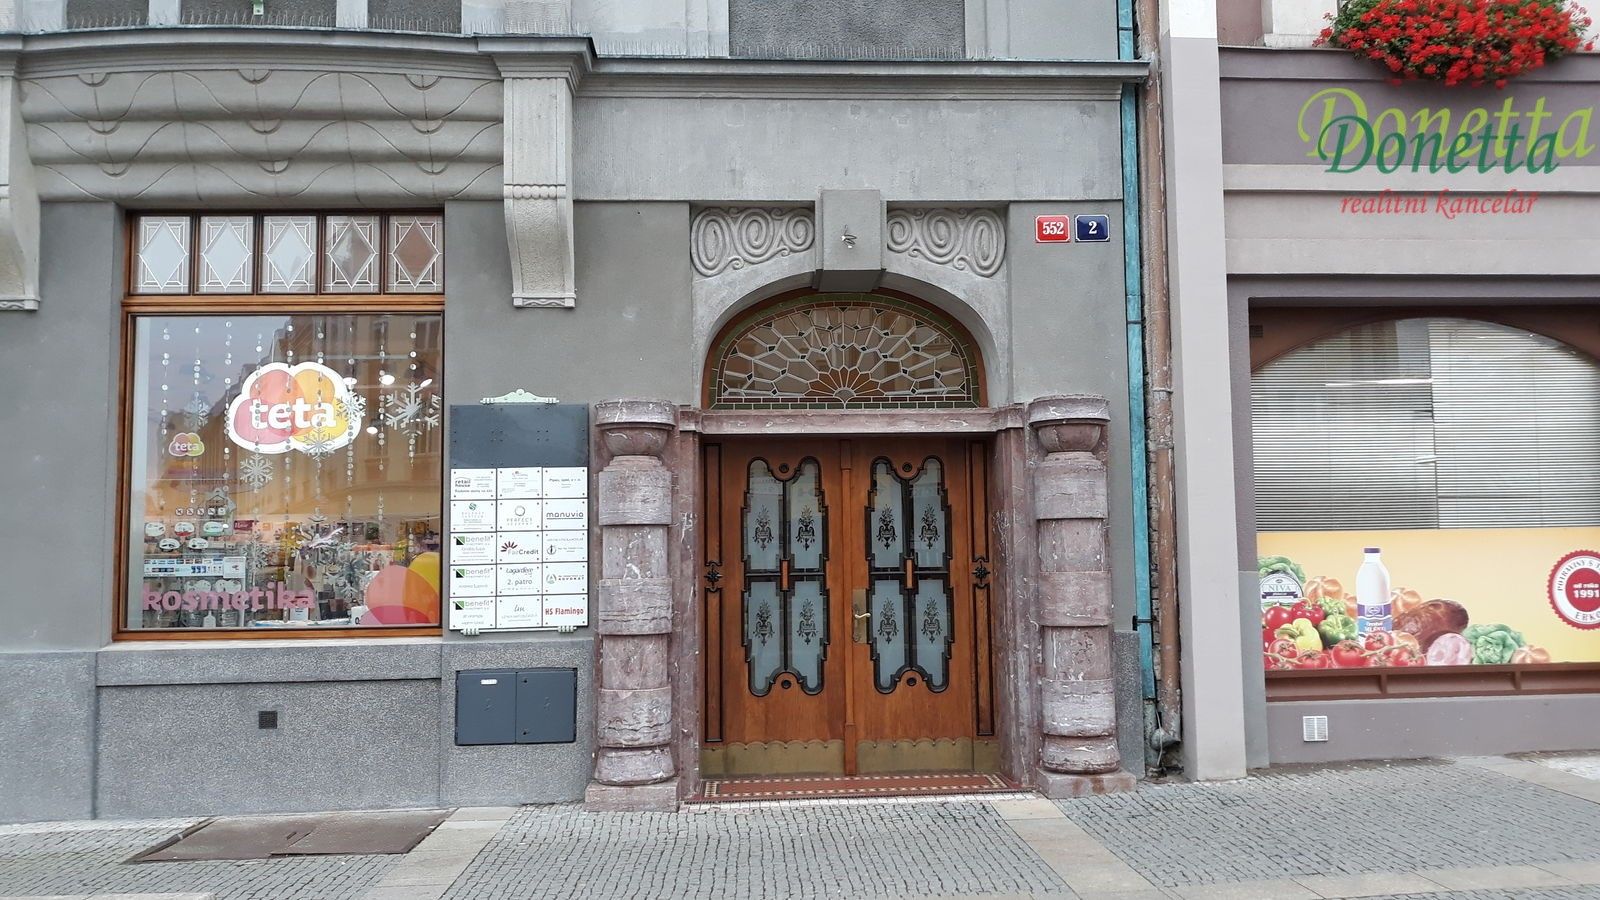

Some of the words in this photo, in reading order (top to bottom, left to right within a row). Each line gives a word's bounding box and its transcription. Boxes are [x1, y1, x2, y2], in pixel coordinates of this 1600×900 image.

[1297, 87, 1596, 159] Donetta
[1318, 115, 1560, 174] Donetta
[1042, 221, 1065, 235] 552
[1088, 220, 1098, 235] 2
[249, 396, 336, 429] teta
[174, 441, 200, 452] teta
[546, 510, 584, 518] manuvia
[514, 579, 533, 587] patro
[143, 581, 315, 611] kosmetika
[1573, 589, 1600, 599] 1991
[555, 607, 584, 615] Flamingo
